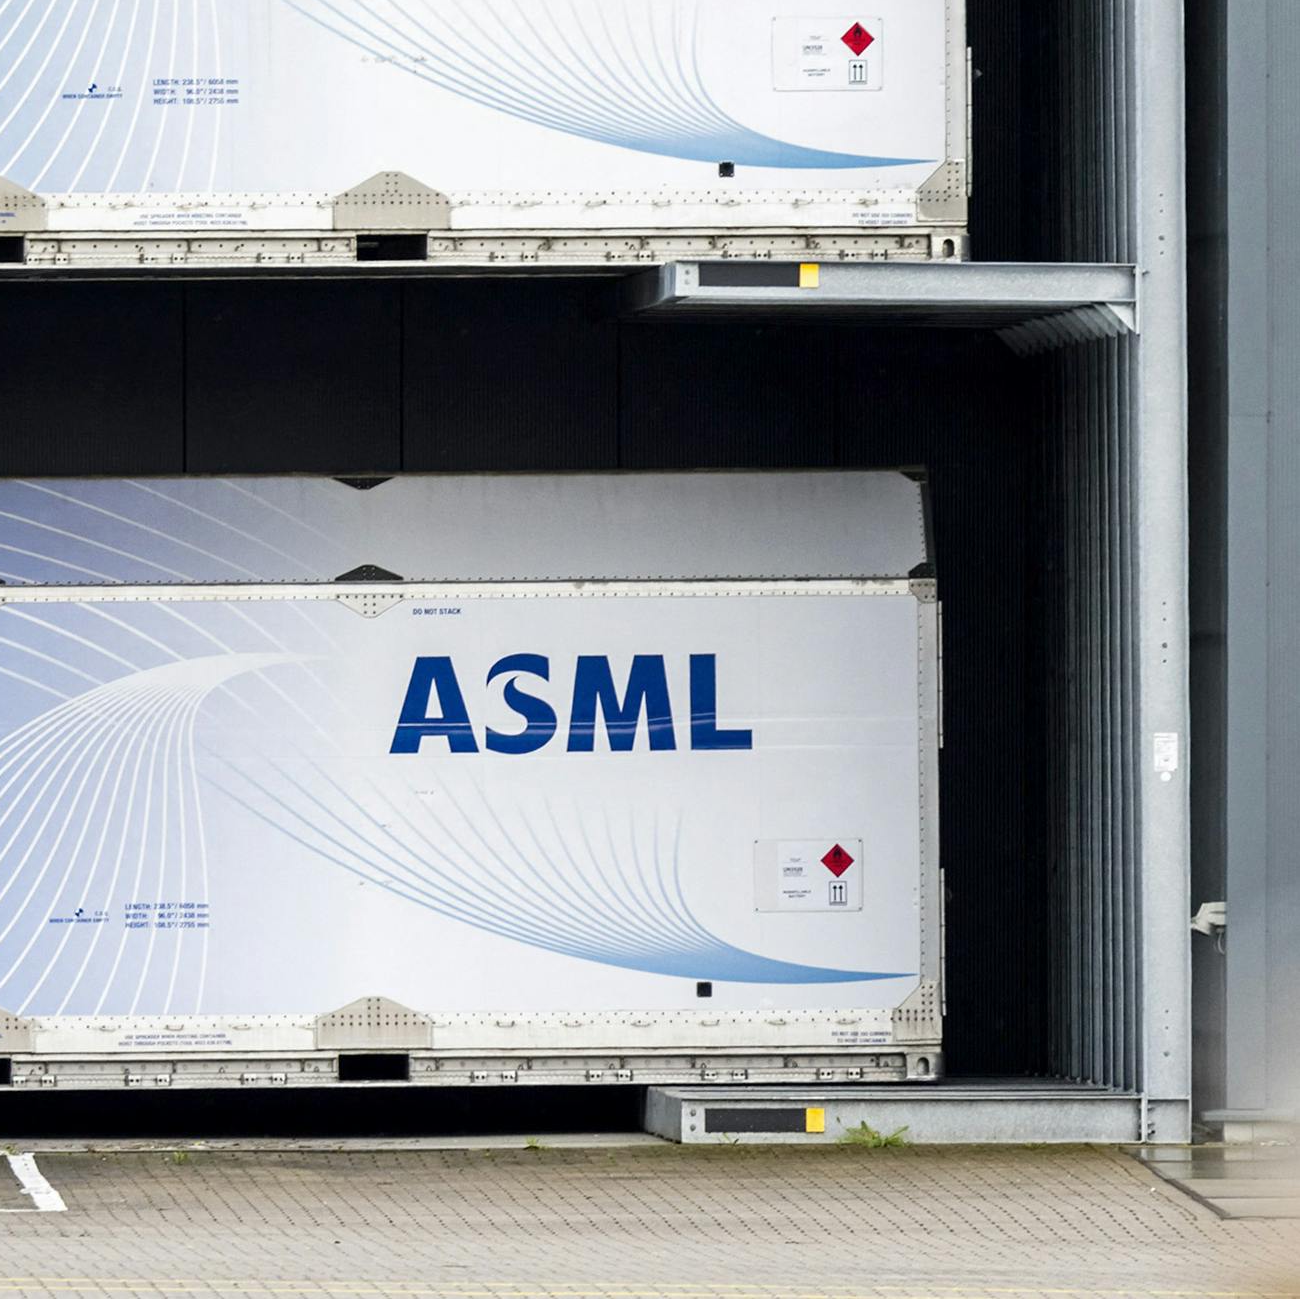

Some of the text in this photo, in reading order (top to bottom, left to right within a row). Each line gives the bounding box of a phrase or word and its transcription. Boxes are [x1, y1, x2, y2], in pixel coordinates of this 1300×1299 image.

[412, 607, 462, 615] DO NOT STACK
[389, 653, 753, 755] ASML
